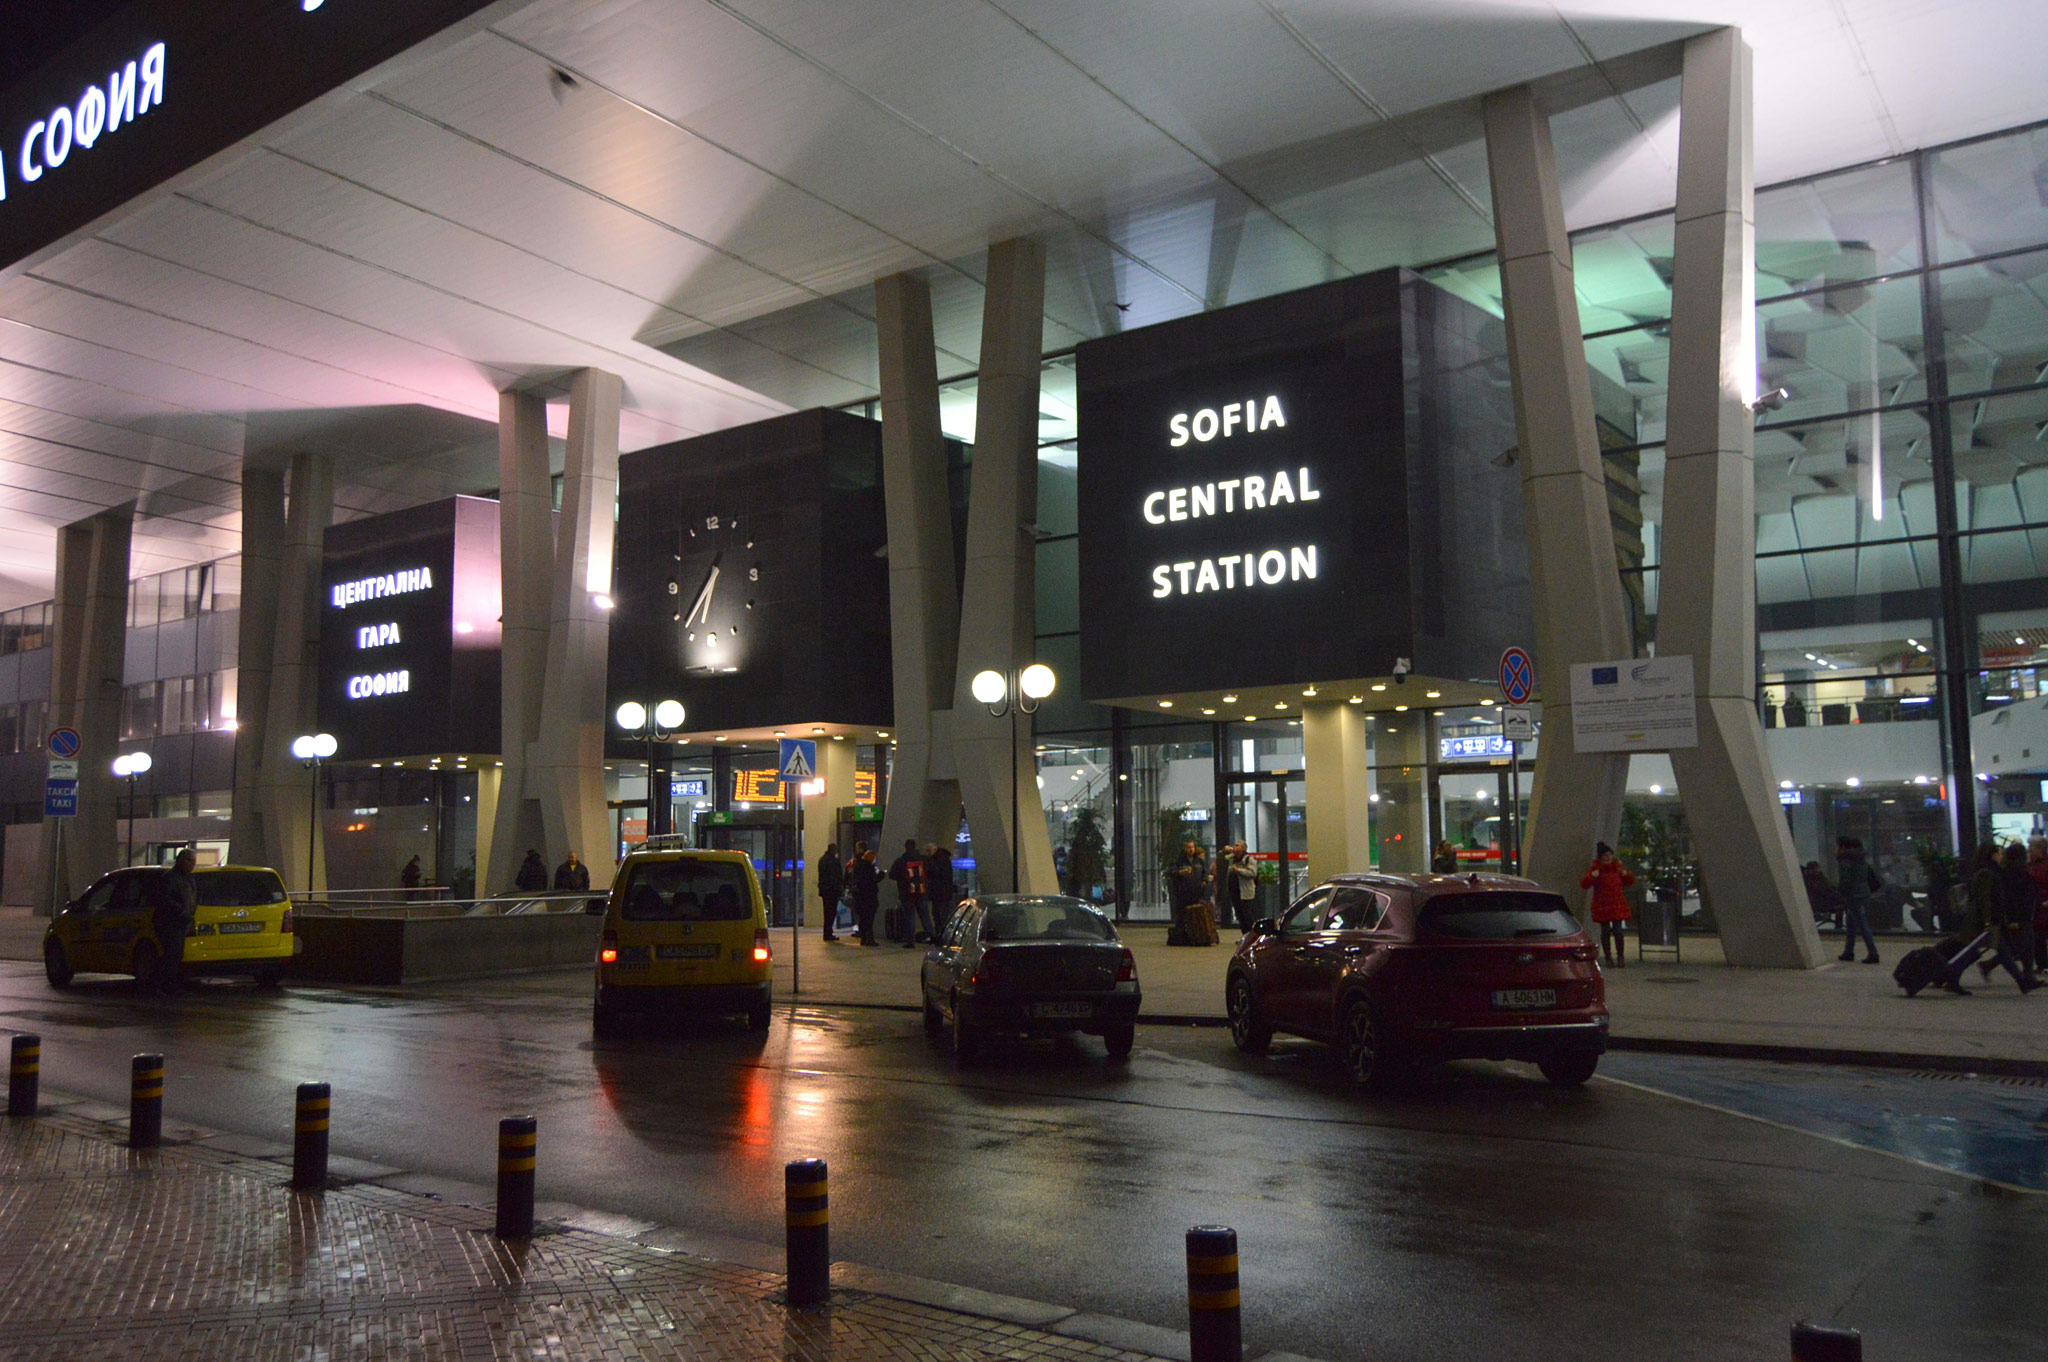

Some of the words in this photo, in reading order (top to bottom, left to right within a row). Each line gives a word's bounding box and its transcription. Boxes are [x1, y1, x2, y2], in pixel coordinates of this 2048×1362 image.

[19, 41, 166, 183] СОФИЯ
[1169, 395, 1287, 447] SOFIA
[1143, 467, 1320, 525] CENTRAL
[706, 516, 719, 530] 12
[749, 568, 759, 582] 3
[1152, 544, 1318, 598] STATION
[331, 566, 433, 609] ЦЕНТРАЛНА
[668, 582, 678, 595] 9
[357, 622, 400, 650] ГАРА
[706, 633, 717, 648] 6
[347, 670, 409, 700] СОФИЯ
[47, 787, 77, 797] ТАКСИ
[51, 798, 72, 808] TAXI
